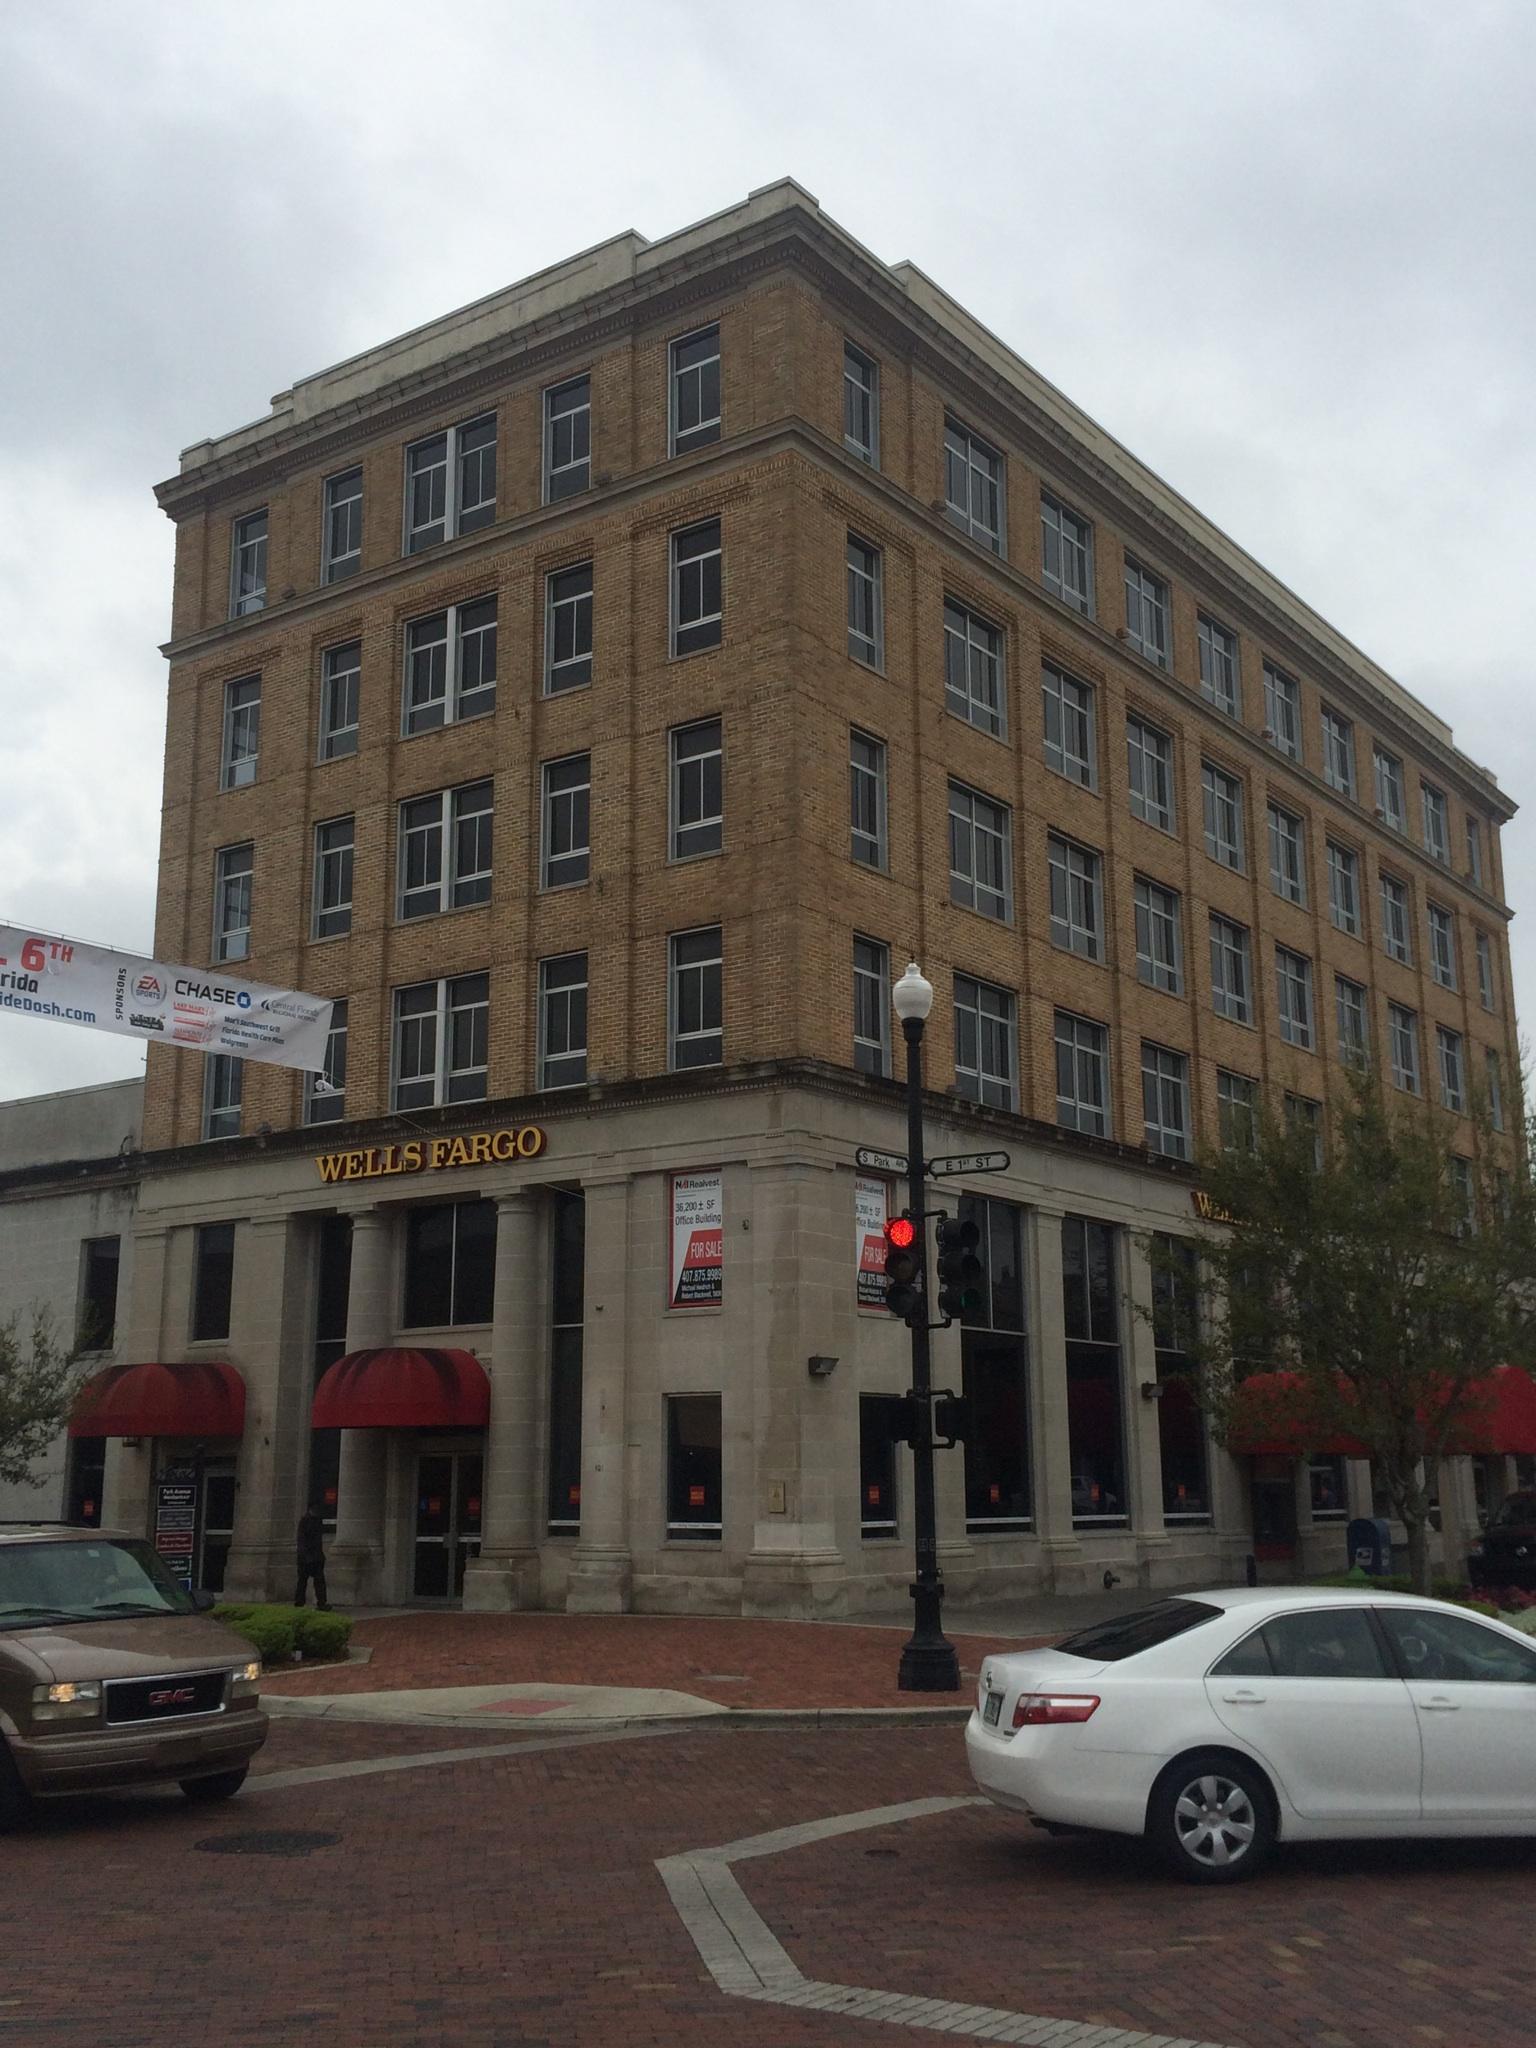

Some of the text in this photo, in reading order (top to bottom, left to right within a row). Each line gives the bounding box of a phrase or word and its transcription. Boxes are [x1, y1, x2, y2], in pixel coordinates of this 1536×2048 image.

[137, 975, 160, 992] EA
[115, 967, 127, 1021] SPONSORS
[136, 989, 160, 1000] SPORTS
[174, 979, 236, 1006] CHASE
[315, 1126, 543, 1182] WELLS FARGO
[862, 1152, 868, 1163] S
[874, 1154, 890, 1167] Park
[946, 1160, 953, 1171] E
[976, 1157, 992, 1168] ST
[690, 1178, 720, 1189] Realvest
[675, 1213, 722, 1226] Office Building
[691, 1240, 722, 1259] FOR SALE
[149, 1687, 195, 1705] GMC
